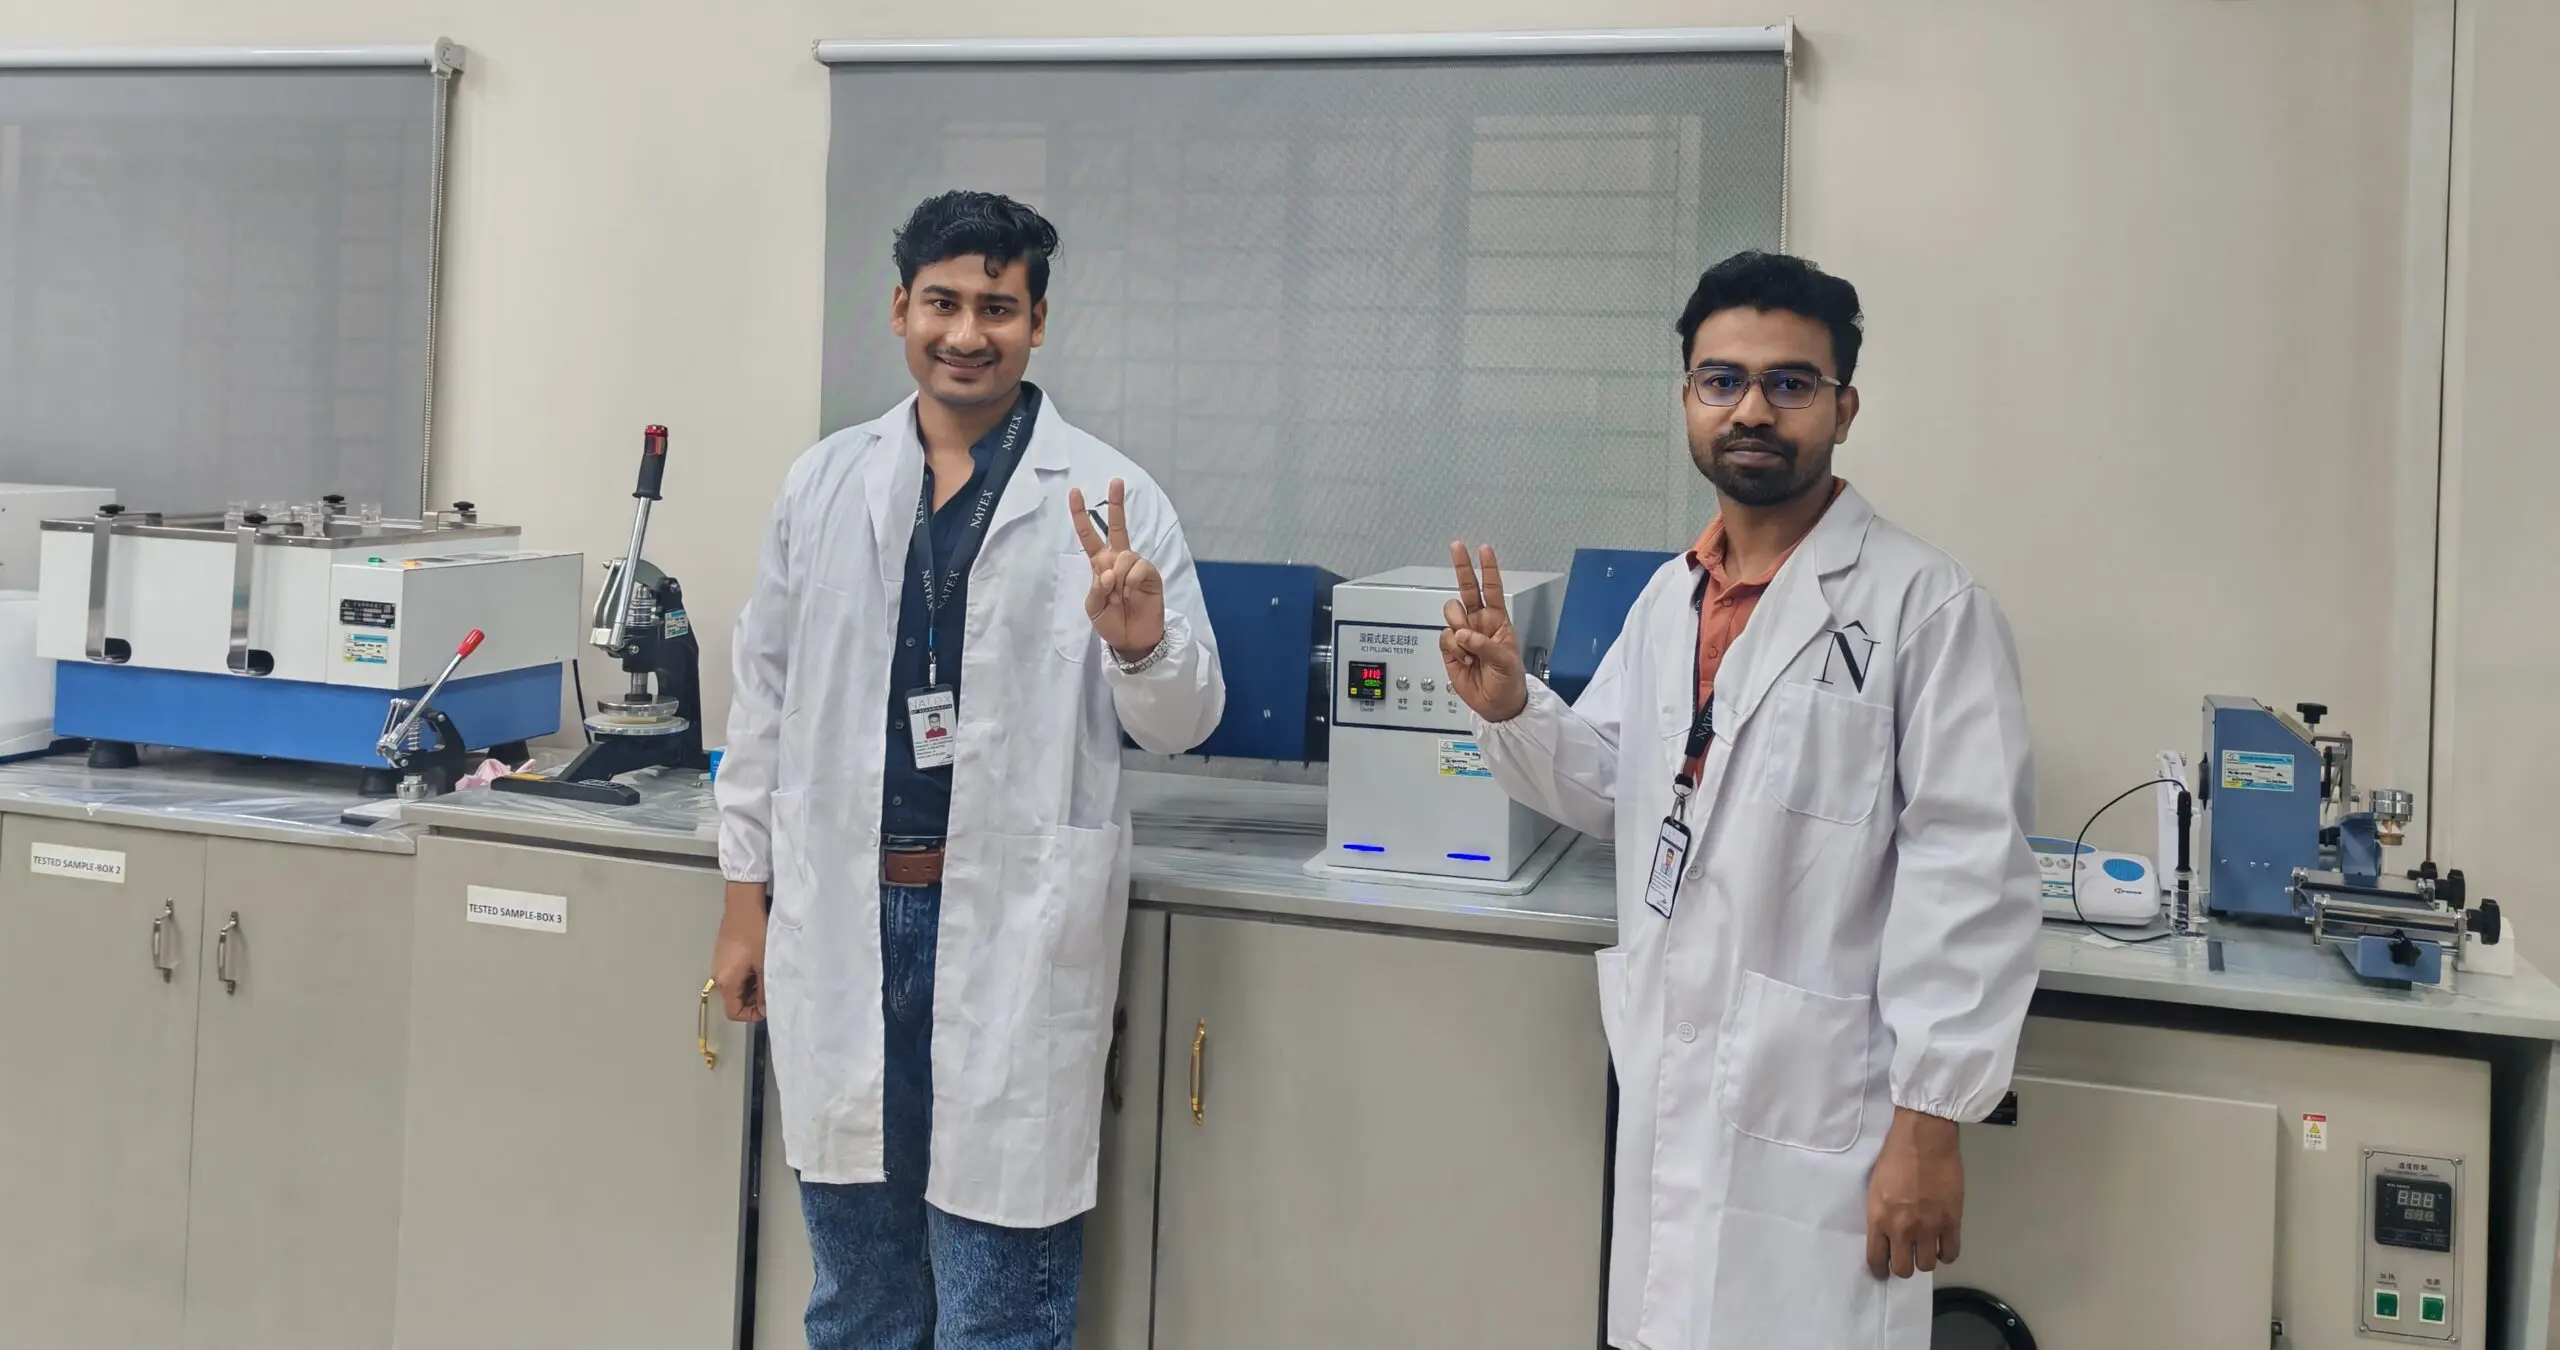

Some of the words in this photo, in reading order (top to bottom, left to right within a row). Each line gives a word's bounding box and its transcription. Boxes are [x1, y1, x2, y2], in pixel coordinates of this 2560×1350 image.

[1002, 415, 1023, 451] NATEX
[970, 489, 994, 529] NATEX
[921, 569, 934, 611] NATEX
[937, 570, 960, 609] NATEX
[33, 855, 61, 867] TESTED
[63, 859, 114, 874] SAMPLE-BOX
[115, 865, 121, 874] 2
[468, 903, 498, 915] TESTED
[500, 907, 555, 923] SAMPLE-BOX
[556, 914, 562, 924] 3
